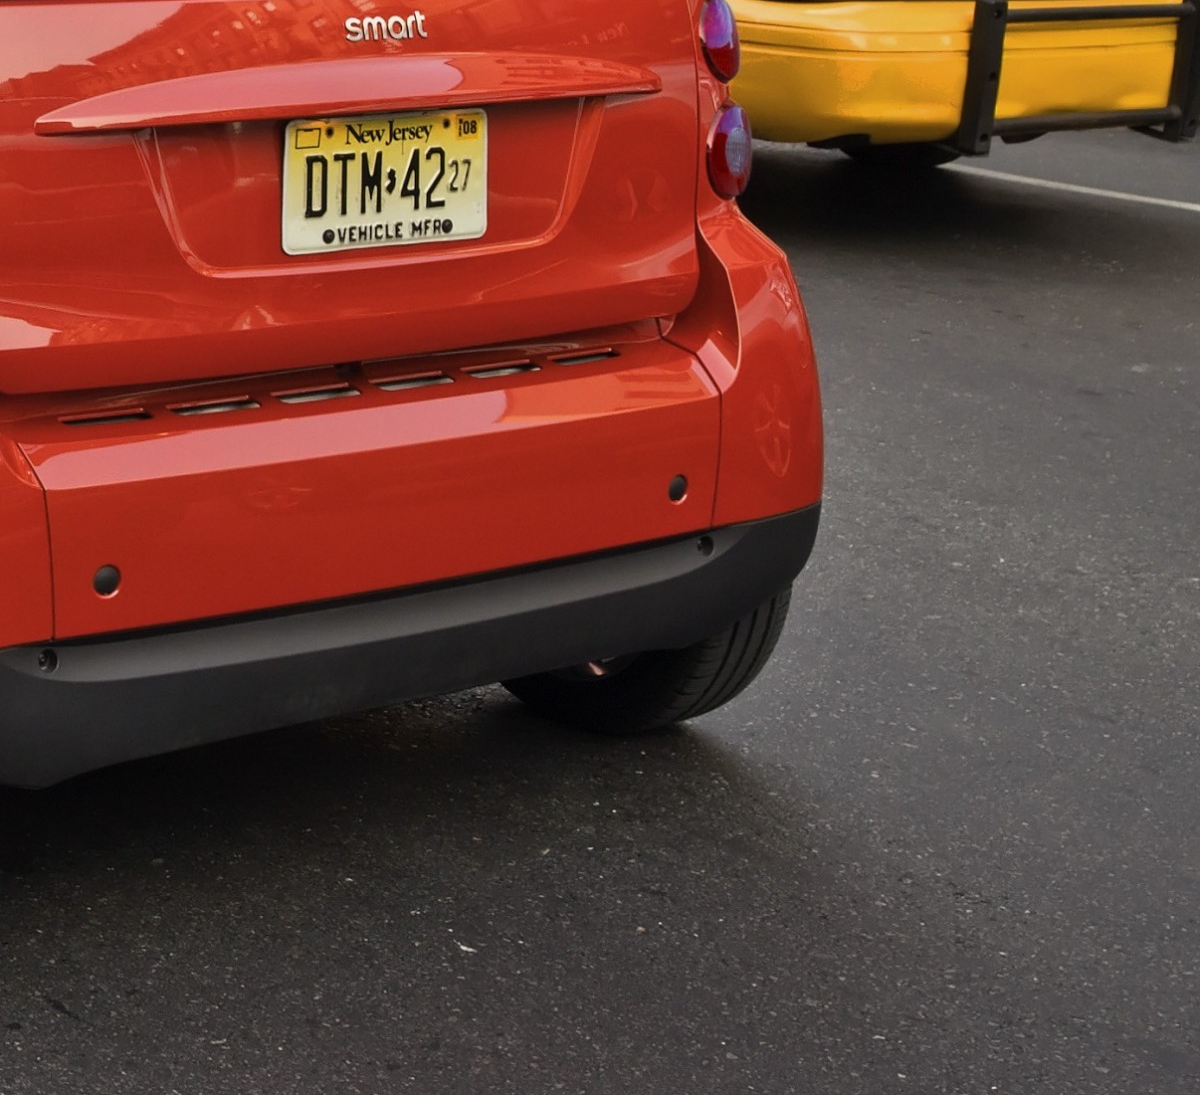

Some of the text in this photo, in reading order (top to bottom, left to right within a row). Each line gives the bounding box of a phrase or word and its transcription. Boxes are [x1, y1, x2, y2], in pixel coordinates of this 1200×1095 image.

[345, 10, 428, 42] smart
[345, 124, 385, 145] New
[385, 120, 433, 146] Jersey
[463, 120, 477, 134] 08
[338, 219, 442, 243] VEHICLE MFR
